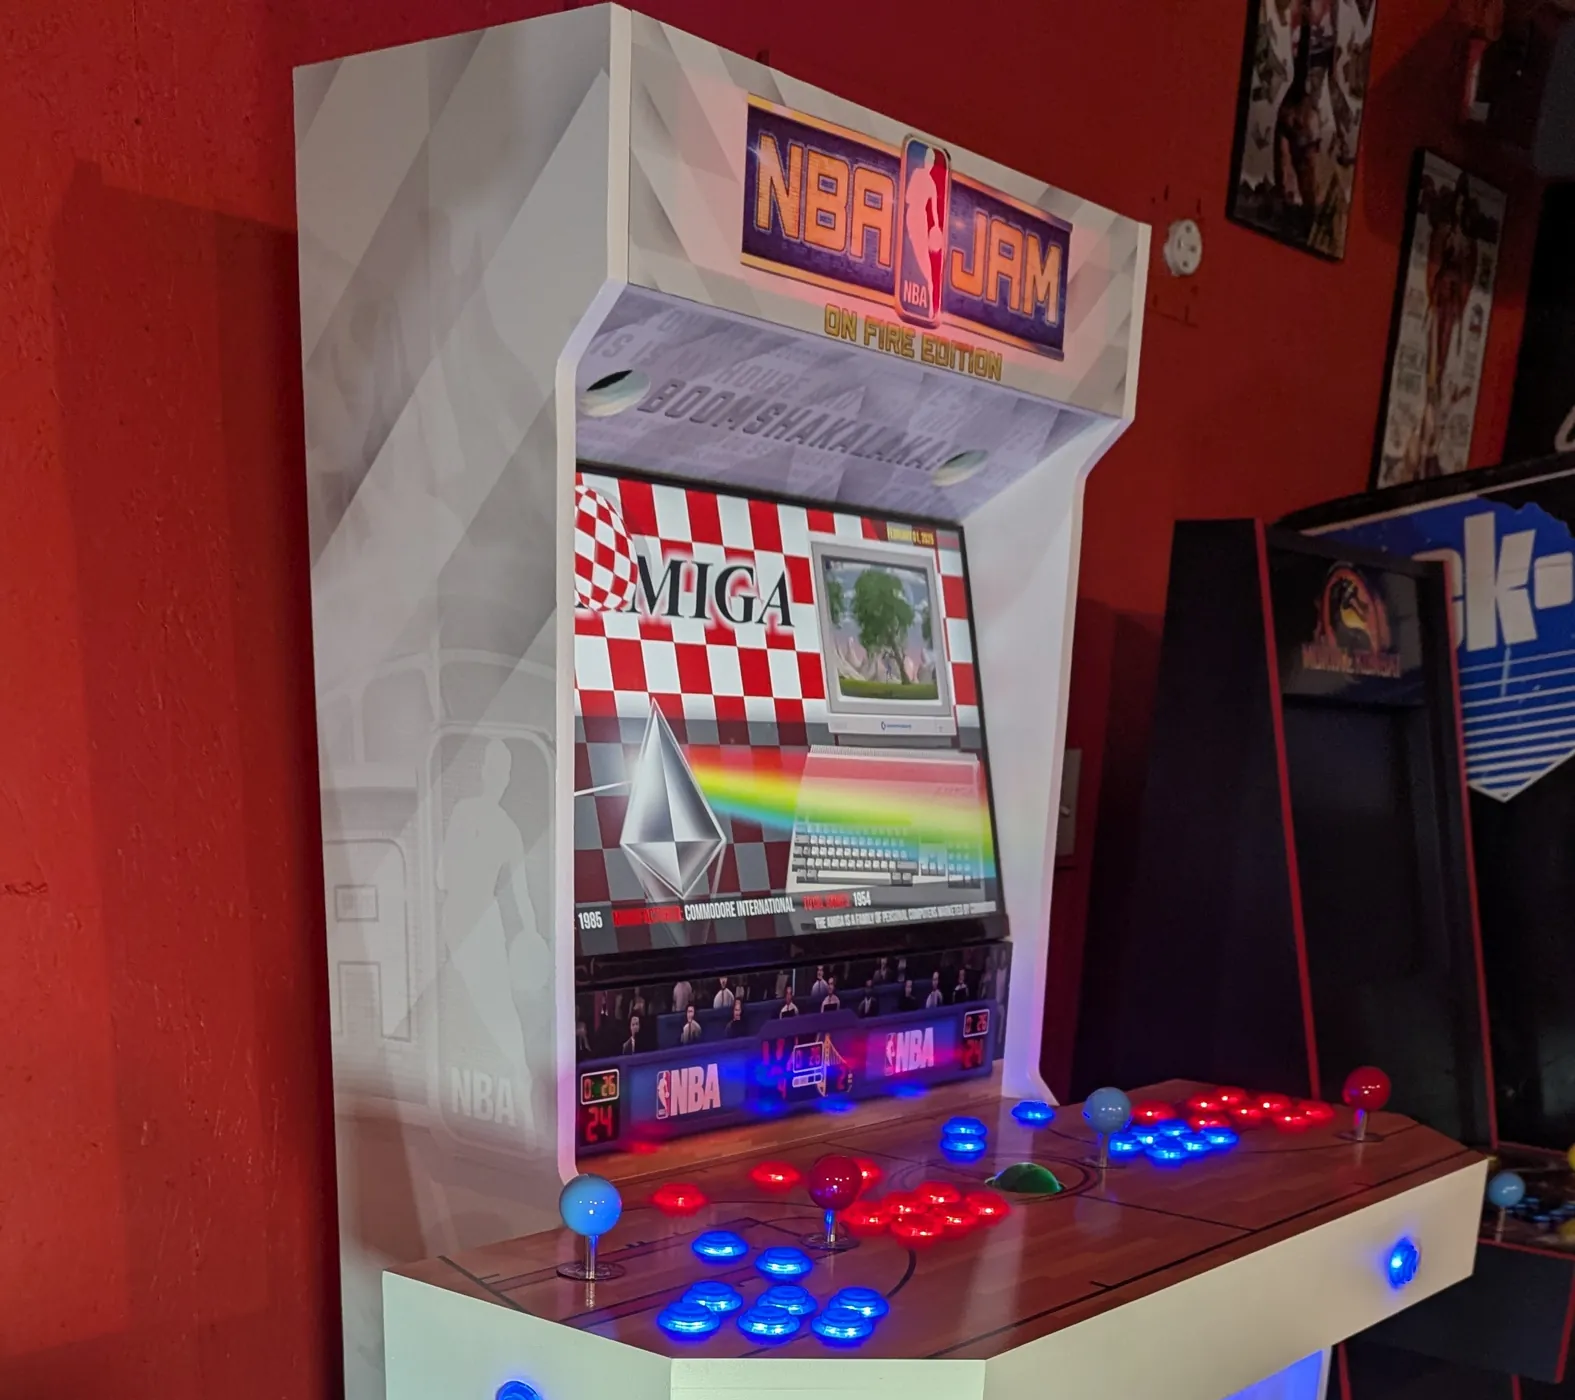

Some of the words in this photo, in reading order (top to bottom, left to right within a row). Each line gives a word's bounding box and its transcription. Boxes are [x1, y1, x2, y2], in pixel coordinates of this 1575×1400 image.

[755, 131, 896, 268] NBA
[949, 210, 1062, 326] JAM
[903, 279, 928, 310] NBA
[824, 303, 857, 345] ON
[863, 316, 915, 359] FIRE
[921, 337, 1003, 381] EDITION
[575, 555, 795, 628] MIGA
[578, 911, 603, 930] 1985
[684, 901, 737, 922] COMMODORE
[737, 897, 796, 917] INTERNATIONAL
[852, 890, 872, 907] 1954
[894, 1027, 935, 1074] NBA
[450, 1065, 517, 1128] NBA
[670, 1063, 721, 1116] NBA
[585, 1105, 613, 1143] 24
